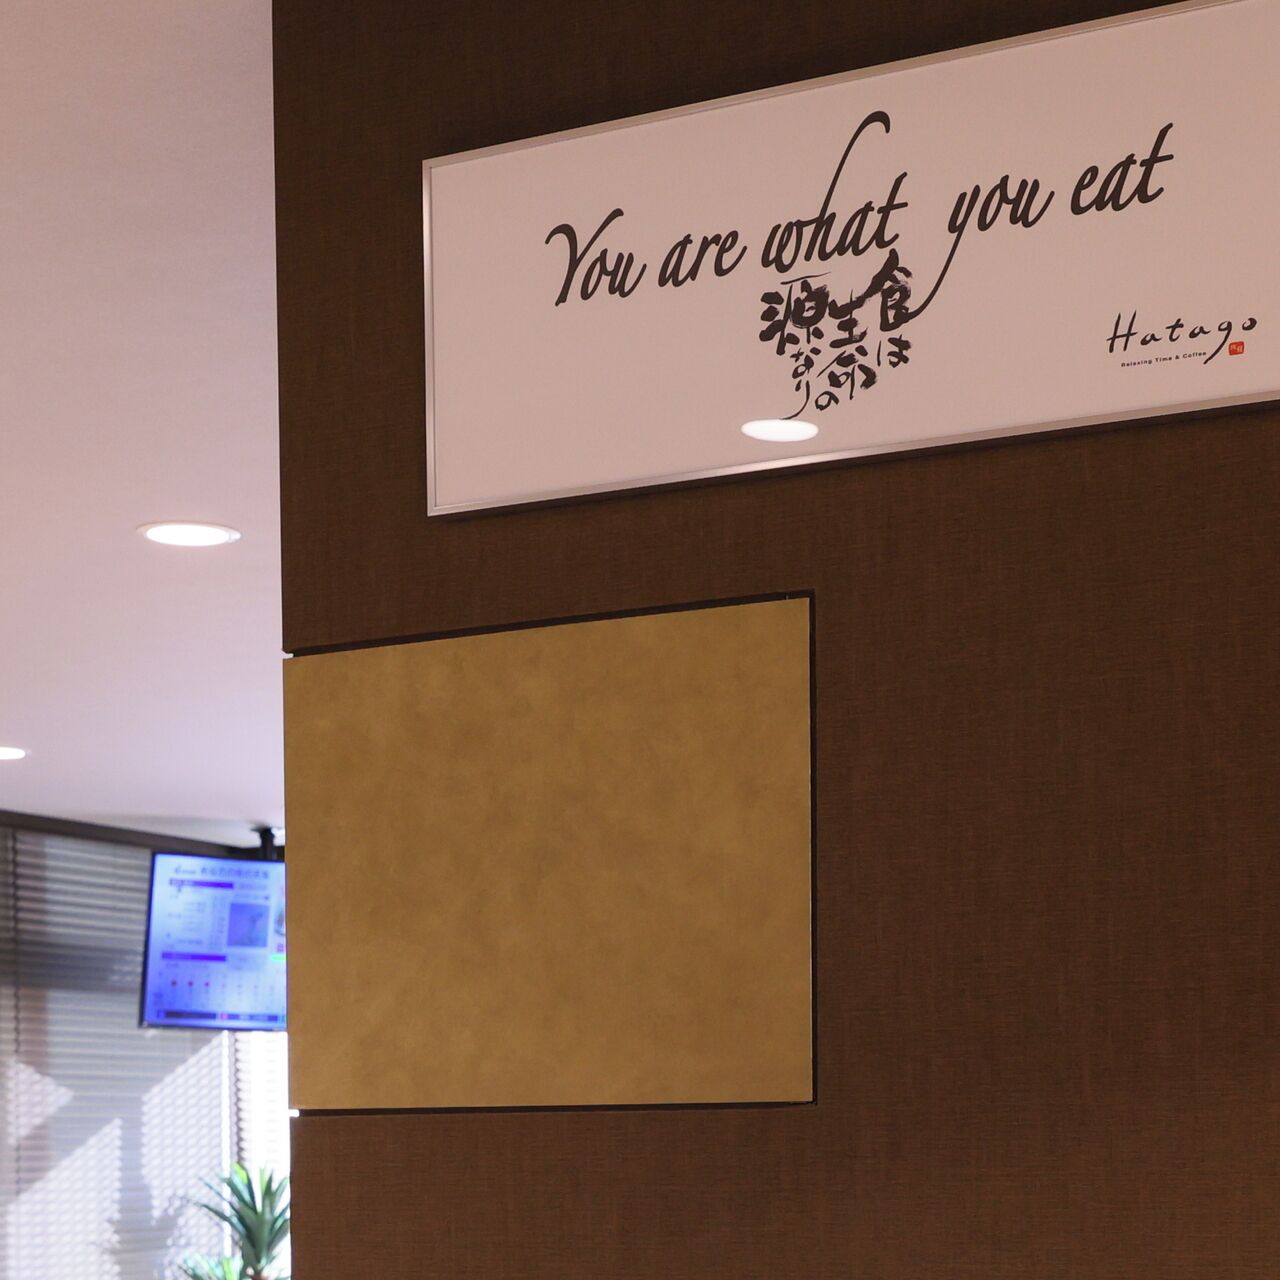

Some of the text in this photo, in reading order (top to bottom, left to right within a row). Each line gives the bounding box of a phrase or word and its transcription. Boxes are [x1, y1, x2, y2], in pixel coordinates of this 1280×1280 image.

[544, 110, 1175, 318] You are what you eat
[1106, 309, 1258, 365] Hatago
[1120, 358, 1153, 368] Relaxing
[1155, 355, 1173, 363] Time
[1183, 351, 1207, 359] Coffee
